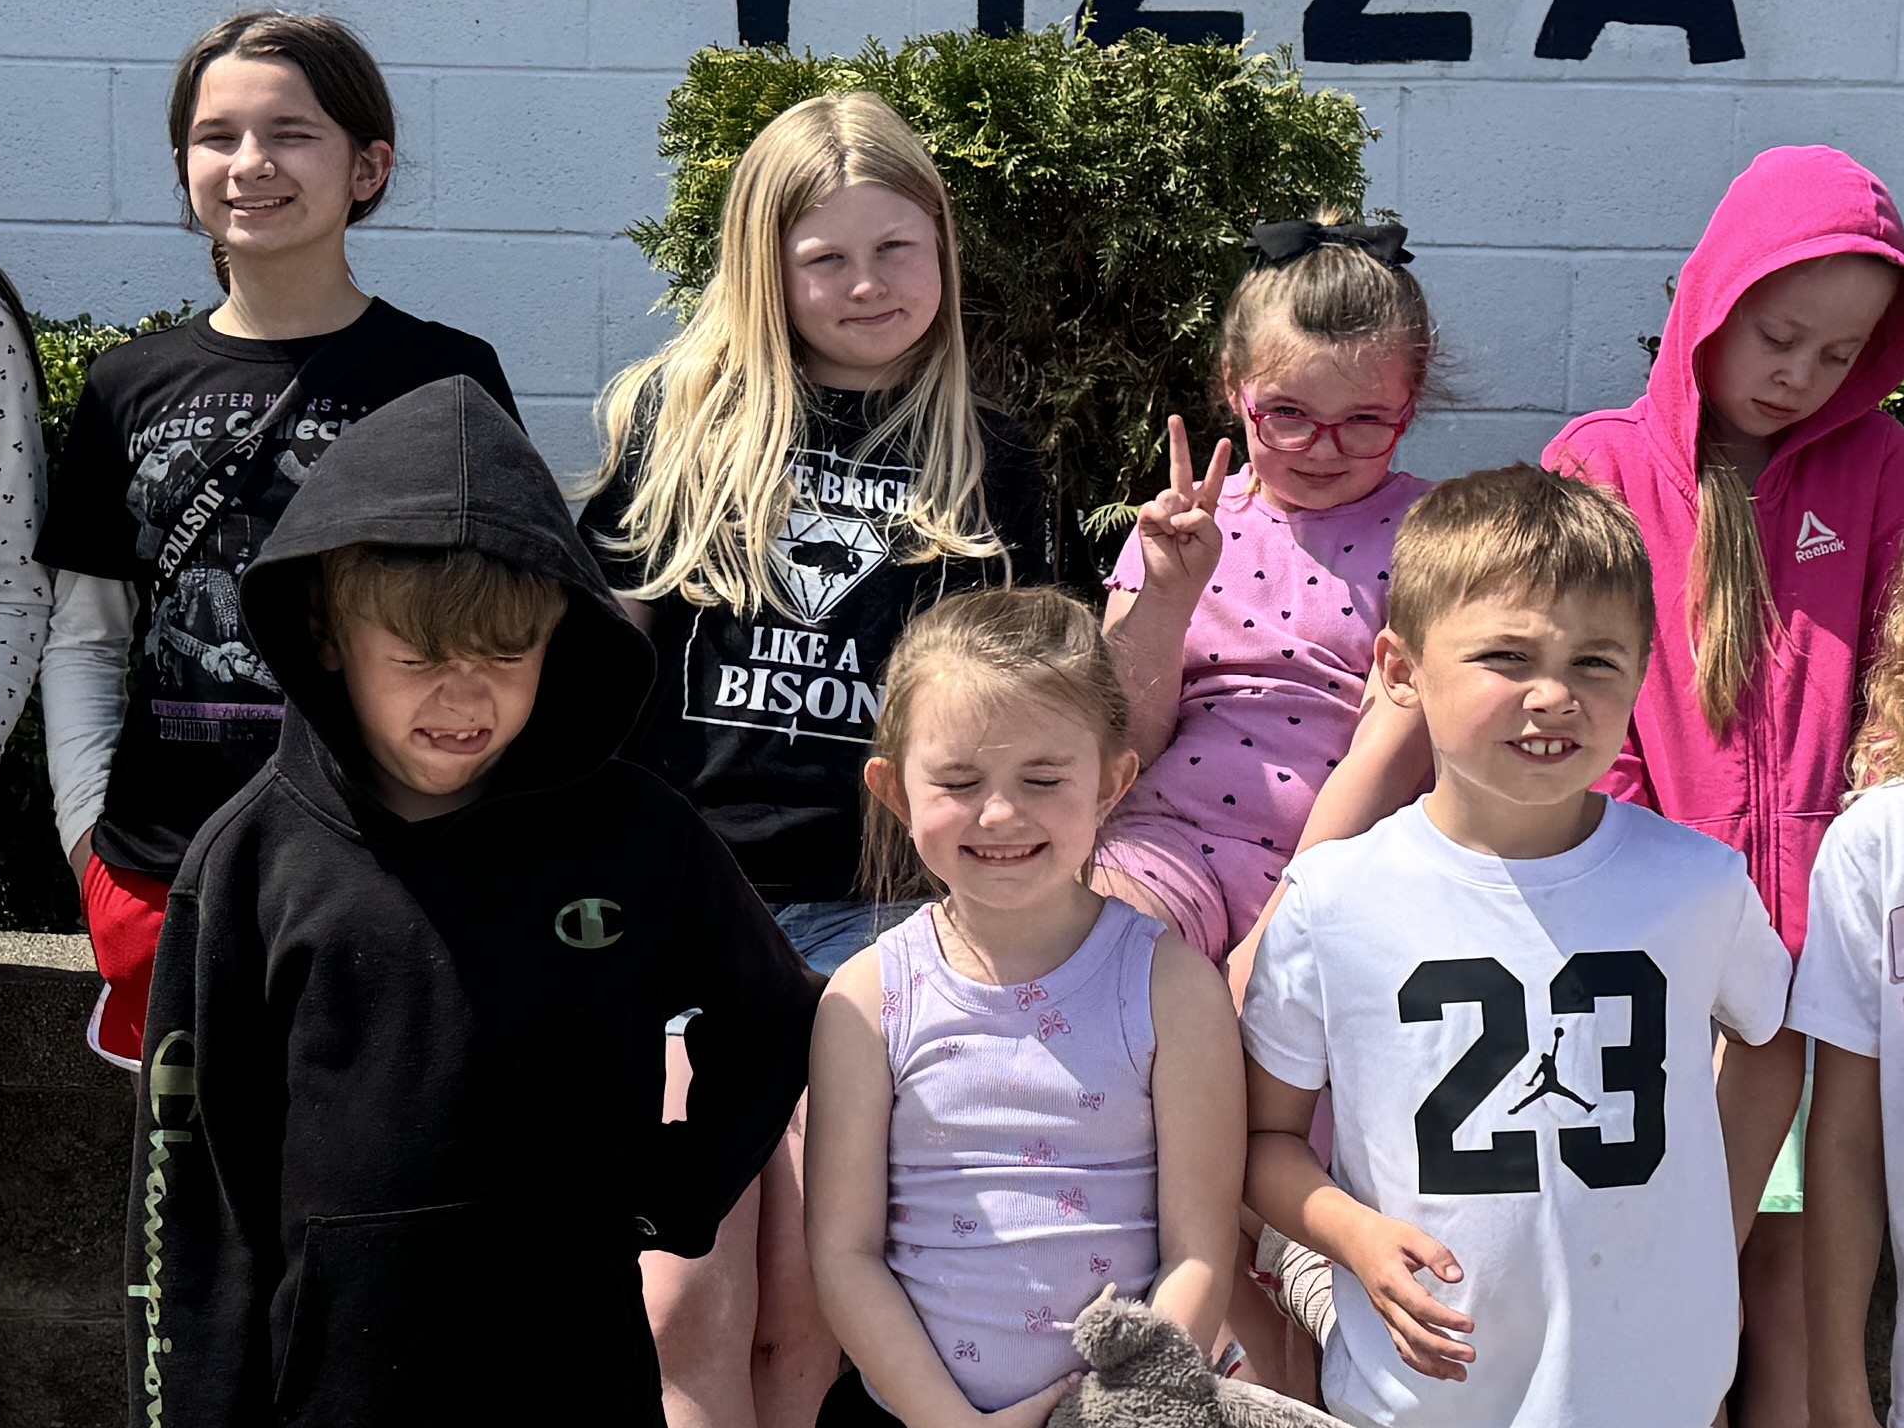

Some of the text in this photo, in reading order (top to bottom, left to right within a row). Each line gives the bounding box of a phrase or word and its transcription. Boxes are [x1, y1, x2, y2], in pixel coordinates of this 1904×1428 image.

[189, 393, 333, 412] AFTER HRS
[128, 411, 215, 463] Music
[159, 478, 226, 579] JUSTICE
[1795, 538, 1846, 564] Reebok
[749, 626, 860, 674] LIKE A
[714, 664, 885, 725] BISON
[1397, 949, 1668, 1195] 23
